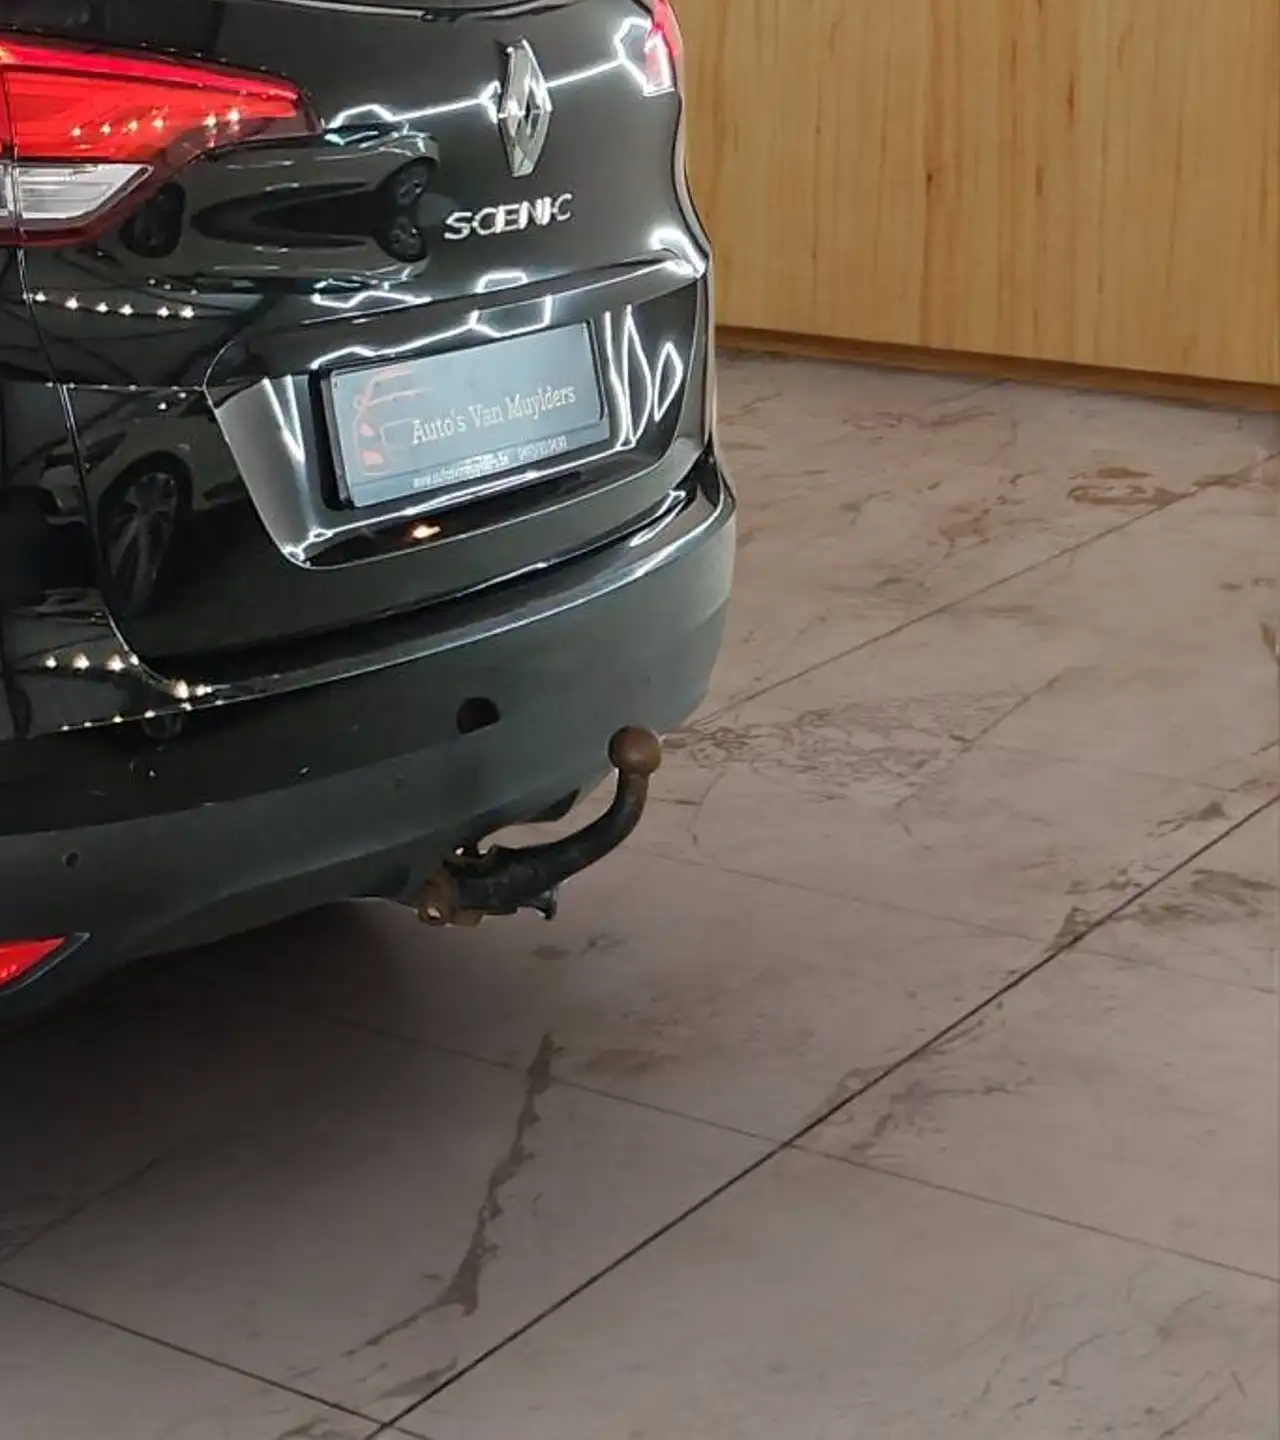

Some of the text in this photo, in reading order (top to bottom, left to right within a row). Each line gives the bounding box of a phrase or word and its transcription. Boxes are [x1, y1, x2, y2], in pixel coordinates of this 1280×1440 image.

[443, 192, 573, 240] SCENIC
[411, 385, 576, 445] Auto's Van Muylders
